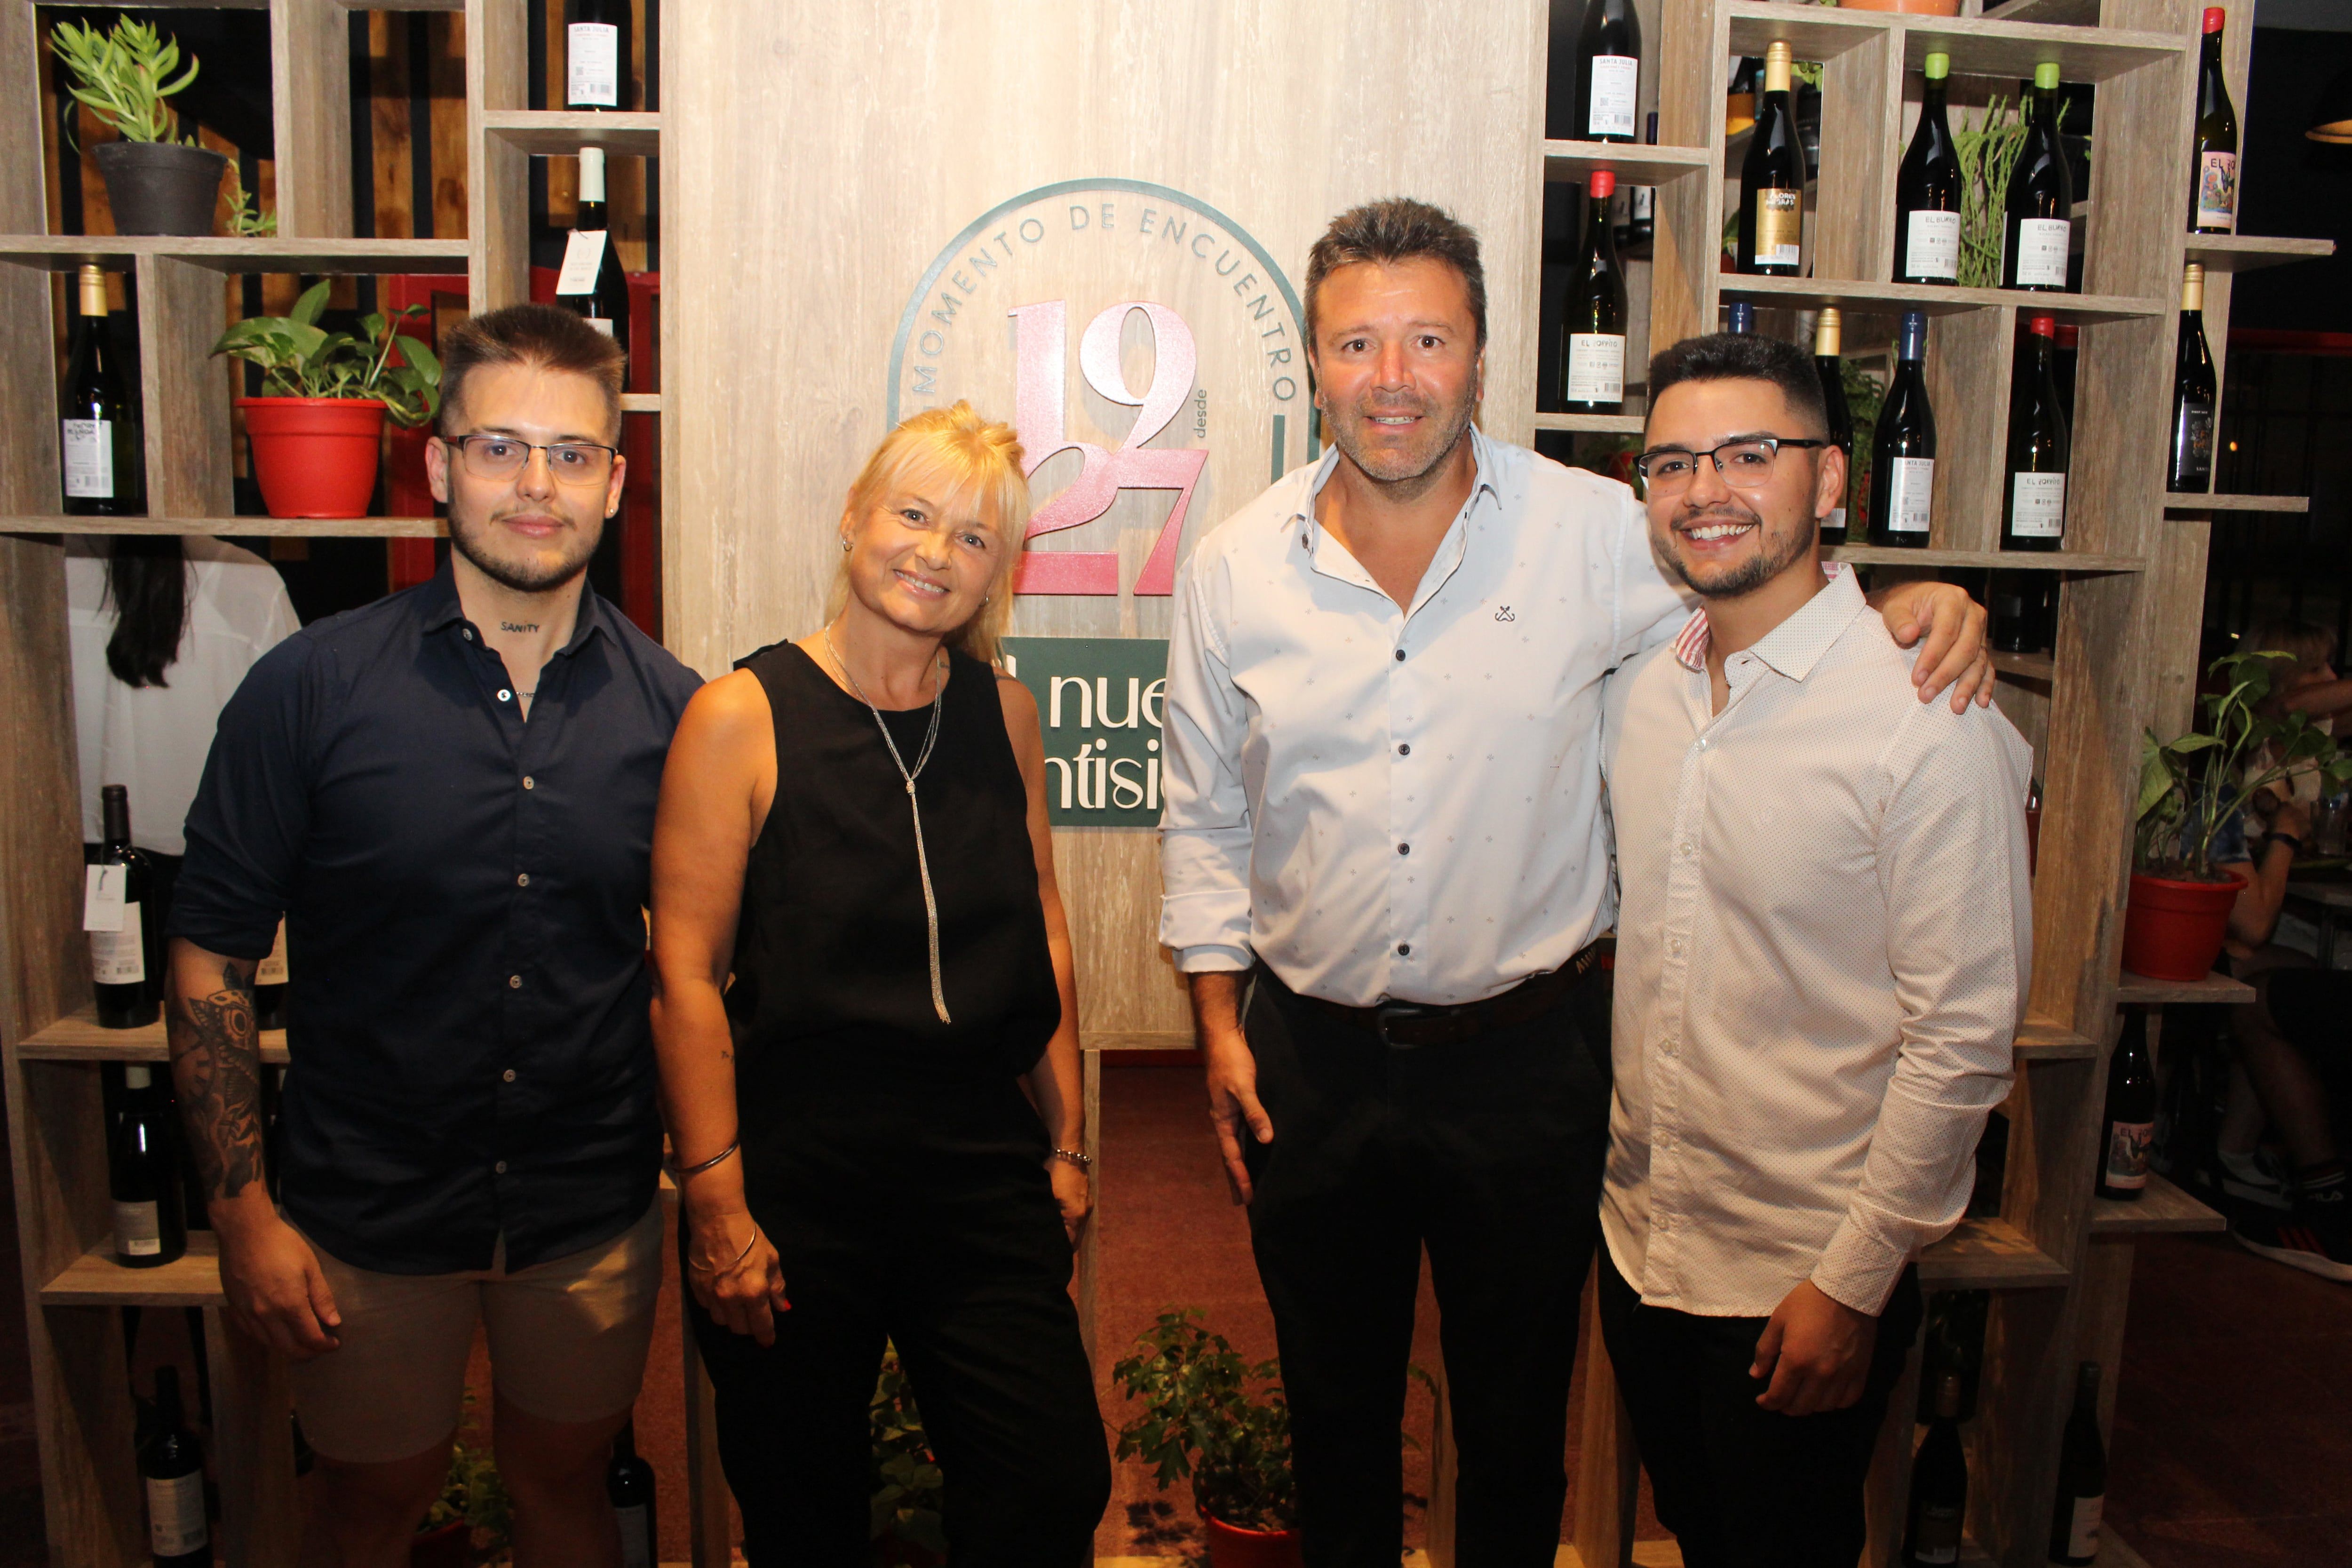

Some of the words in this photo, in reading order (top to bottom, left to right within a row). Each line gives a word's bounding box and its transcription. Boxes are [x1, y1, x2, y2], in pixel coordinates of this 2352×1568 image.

[2211, 159, 2222, 168] EL
[913, 218, 1044, 393] MOMENTO
[1070, 203, 1114, 230] DE
[1139, 208, 1296, 401] ENCUENTRO
[1194, 389, 1207, 438] desde
[501, 621, 540, 633] SANITY
[1044, 738, 1165, 809] ntisi
